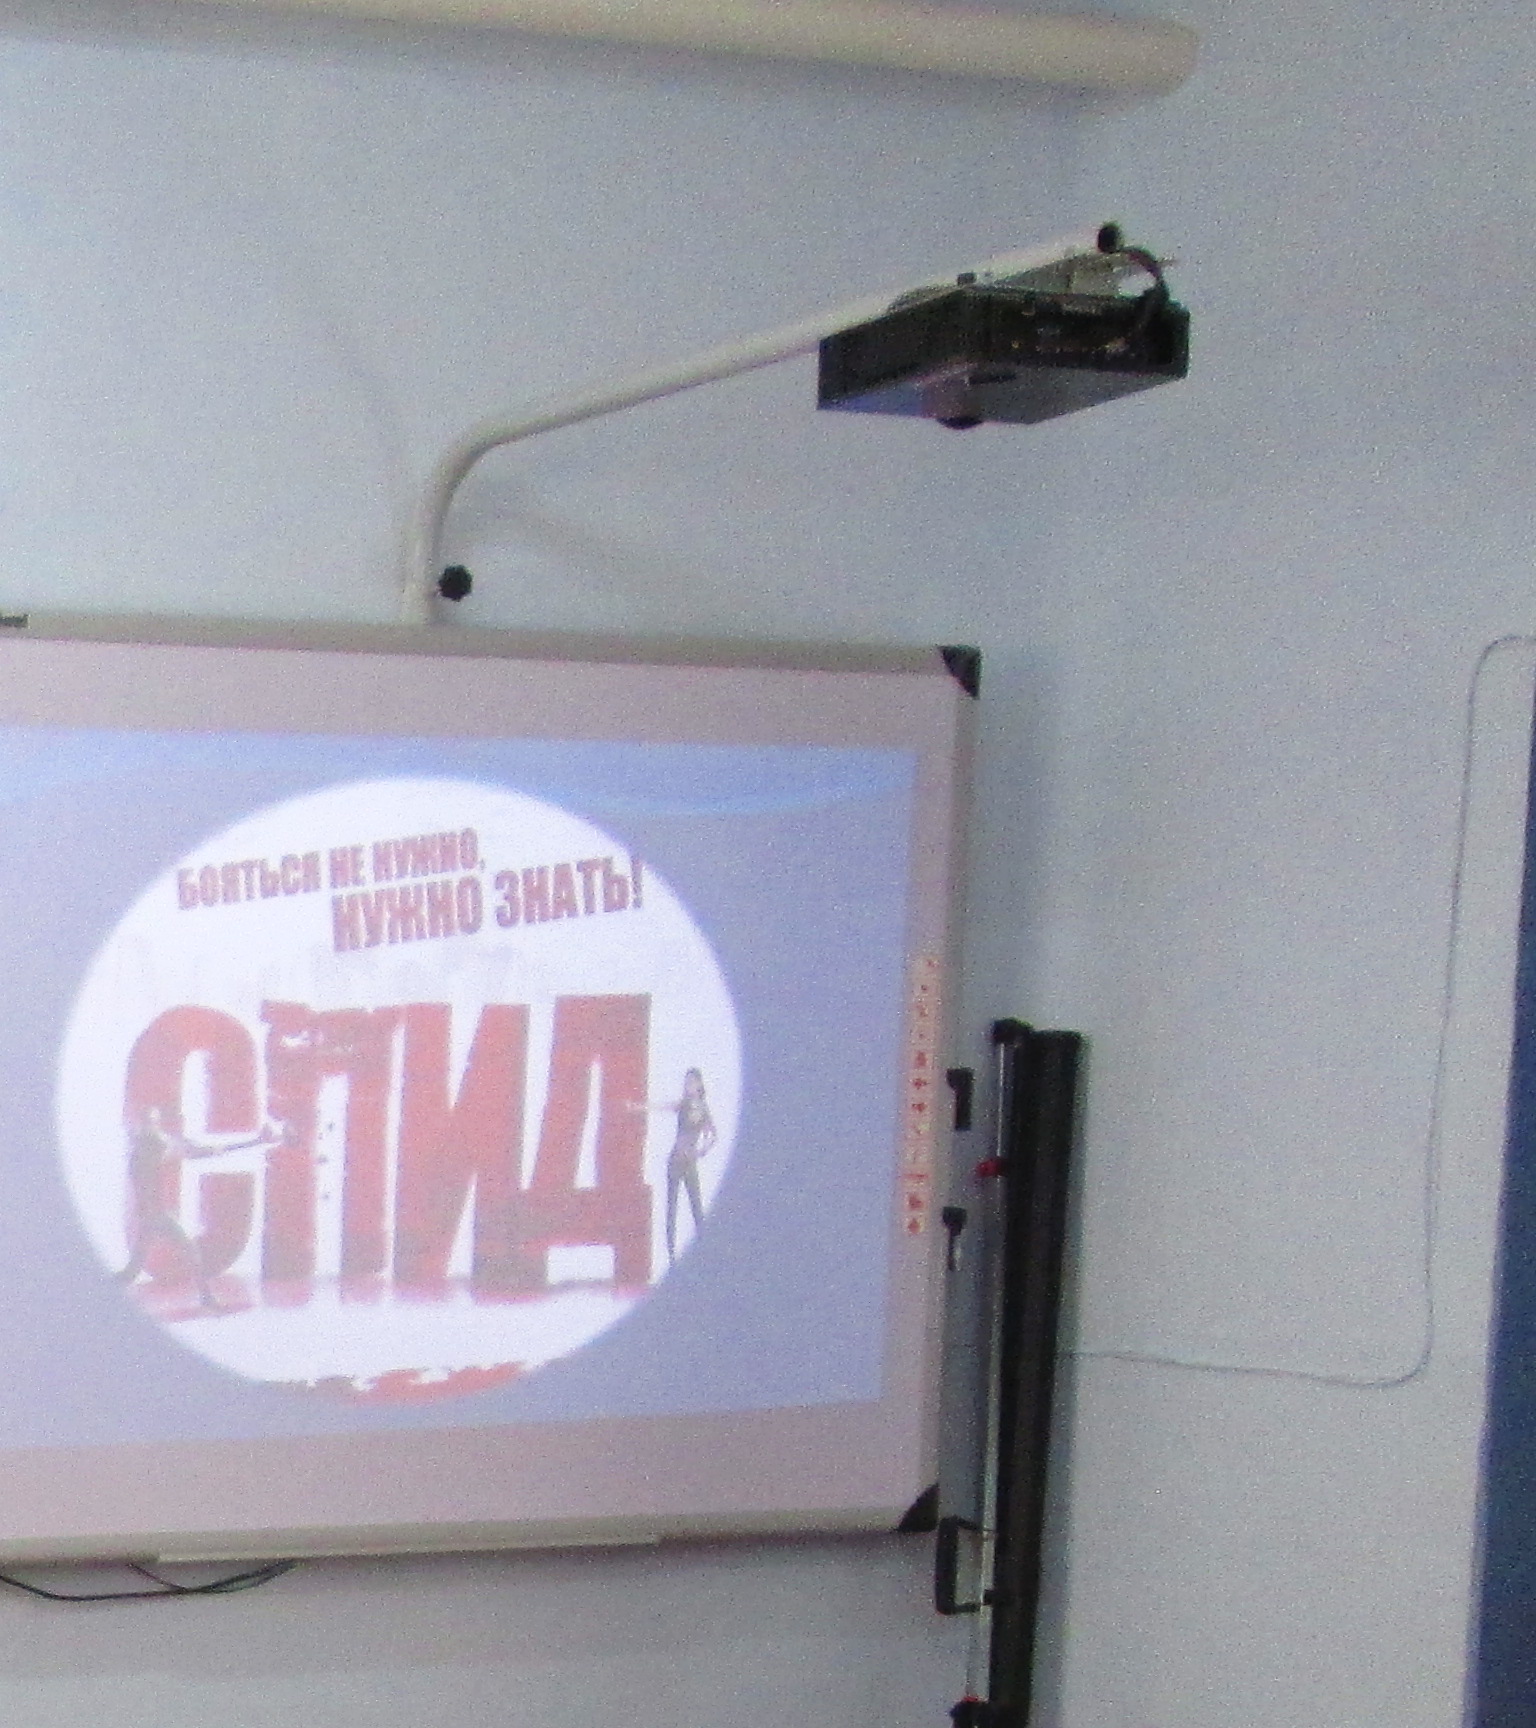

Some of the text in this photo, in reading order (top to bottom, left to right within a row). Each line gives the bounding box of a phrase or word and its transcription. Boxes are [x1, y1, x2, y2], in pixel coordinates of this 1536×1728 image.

[328, 844, 365, 889] НЕ
[331, 875, 484, 953] НУЖНО
[124, 993, 654, 1310] СПИД
